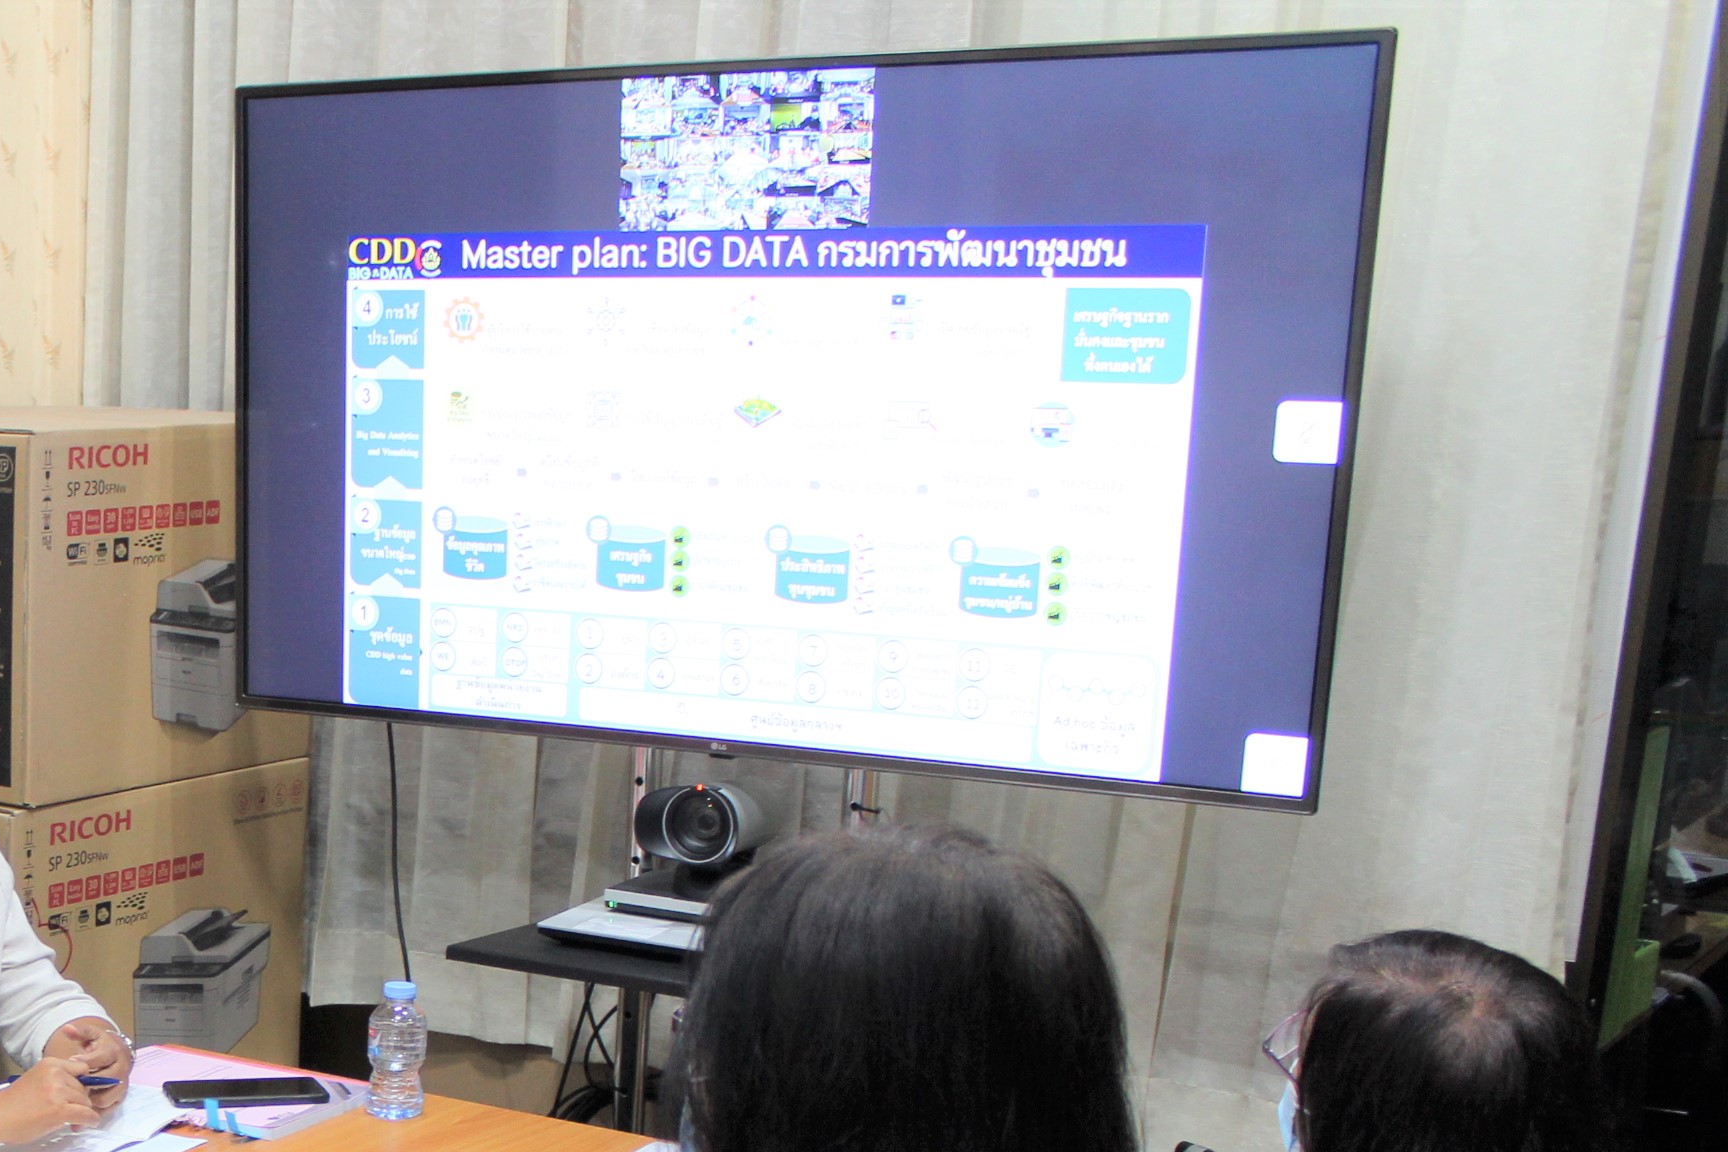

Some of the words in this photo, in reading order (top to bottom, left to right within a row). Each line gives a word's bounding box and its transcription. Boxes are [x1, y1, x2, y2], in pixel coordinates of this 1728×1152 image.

[349, 238, 416, 264] CDD
[462, 239, 563, 270] Master
[573, 236, 647, 275] plan:
[657, 236, 711, 268] BIG
[723, 236, 808, 267] DATA
[817, 228, 1127, 278] กรมการพัฒนาชุมชน
[363, 300, 371, 315] 4
[362, 388, 371, 404] 3
[68, 443, 149, 470] RICOH
[67, 481, 81, 497] SP
[105, 512, 116, 524] 30
[361, 508, 370, 523] 2
[50, 809, 131, 845] RICOH
[48, 855, 63, 871] SP
